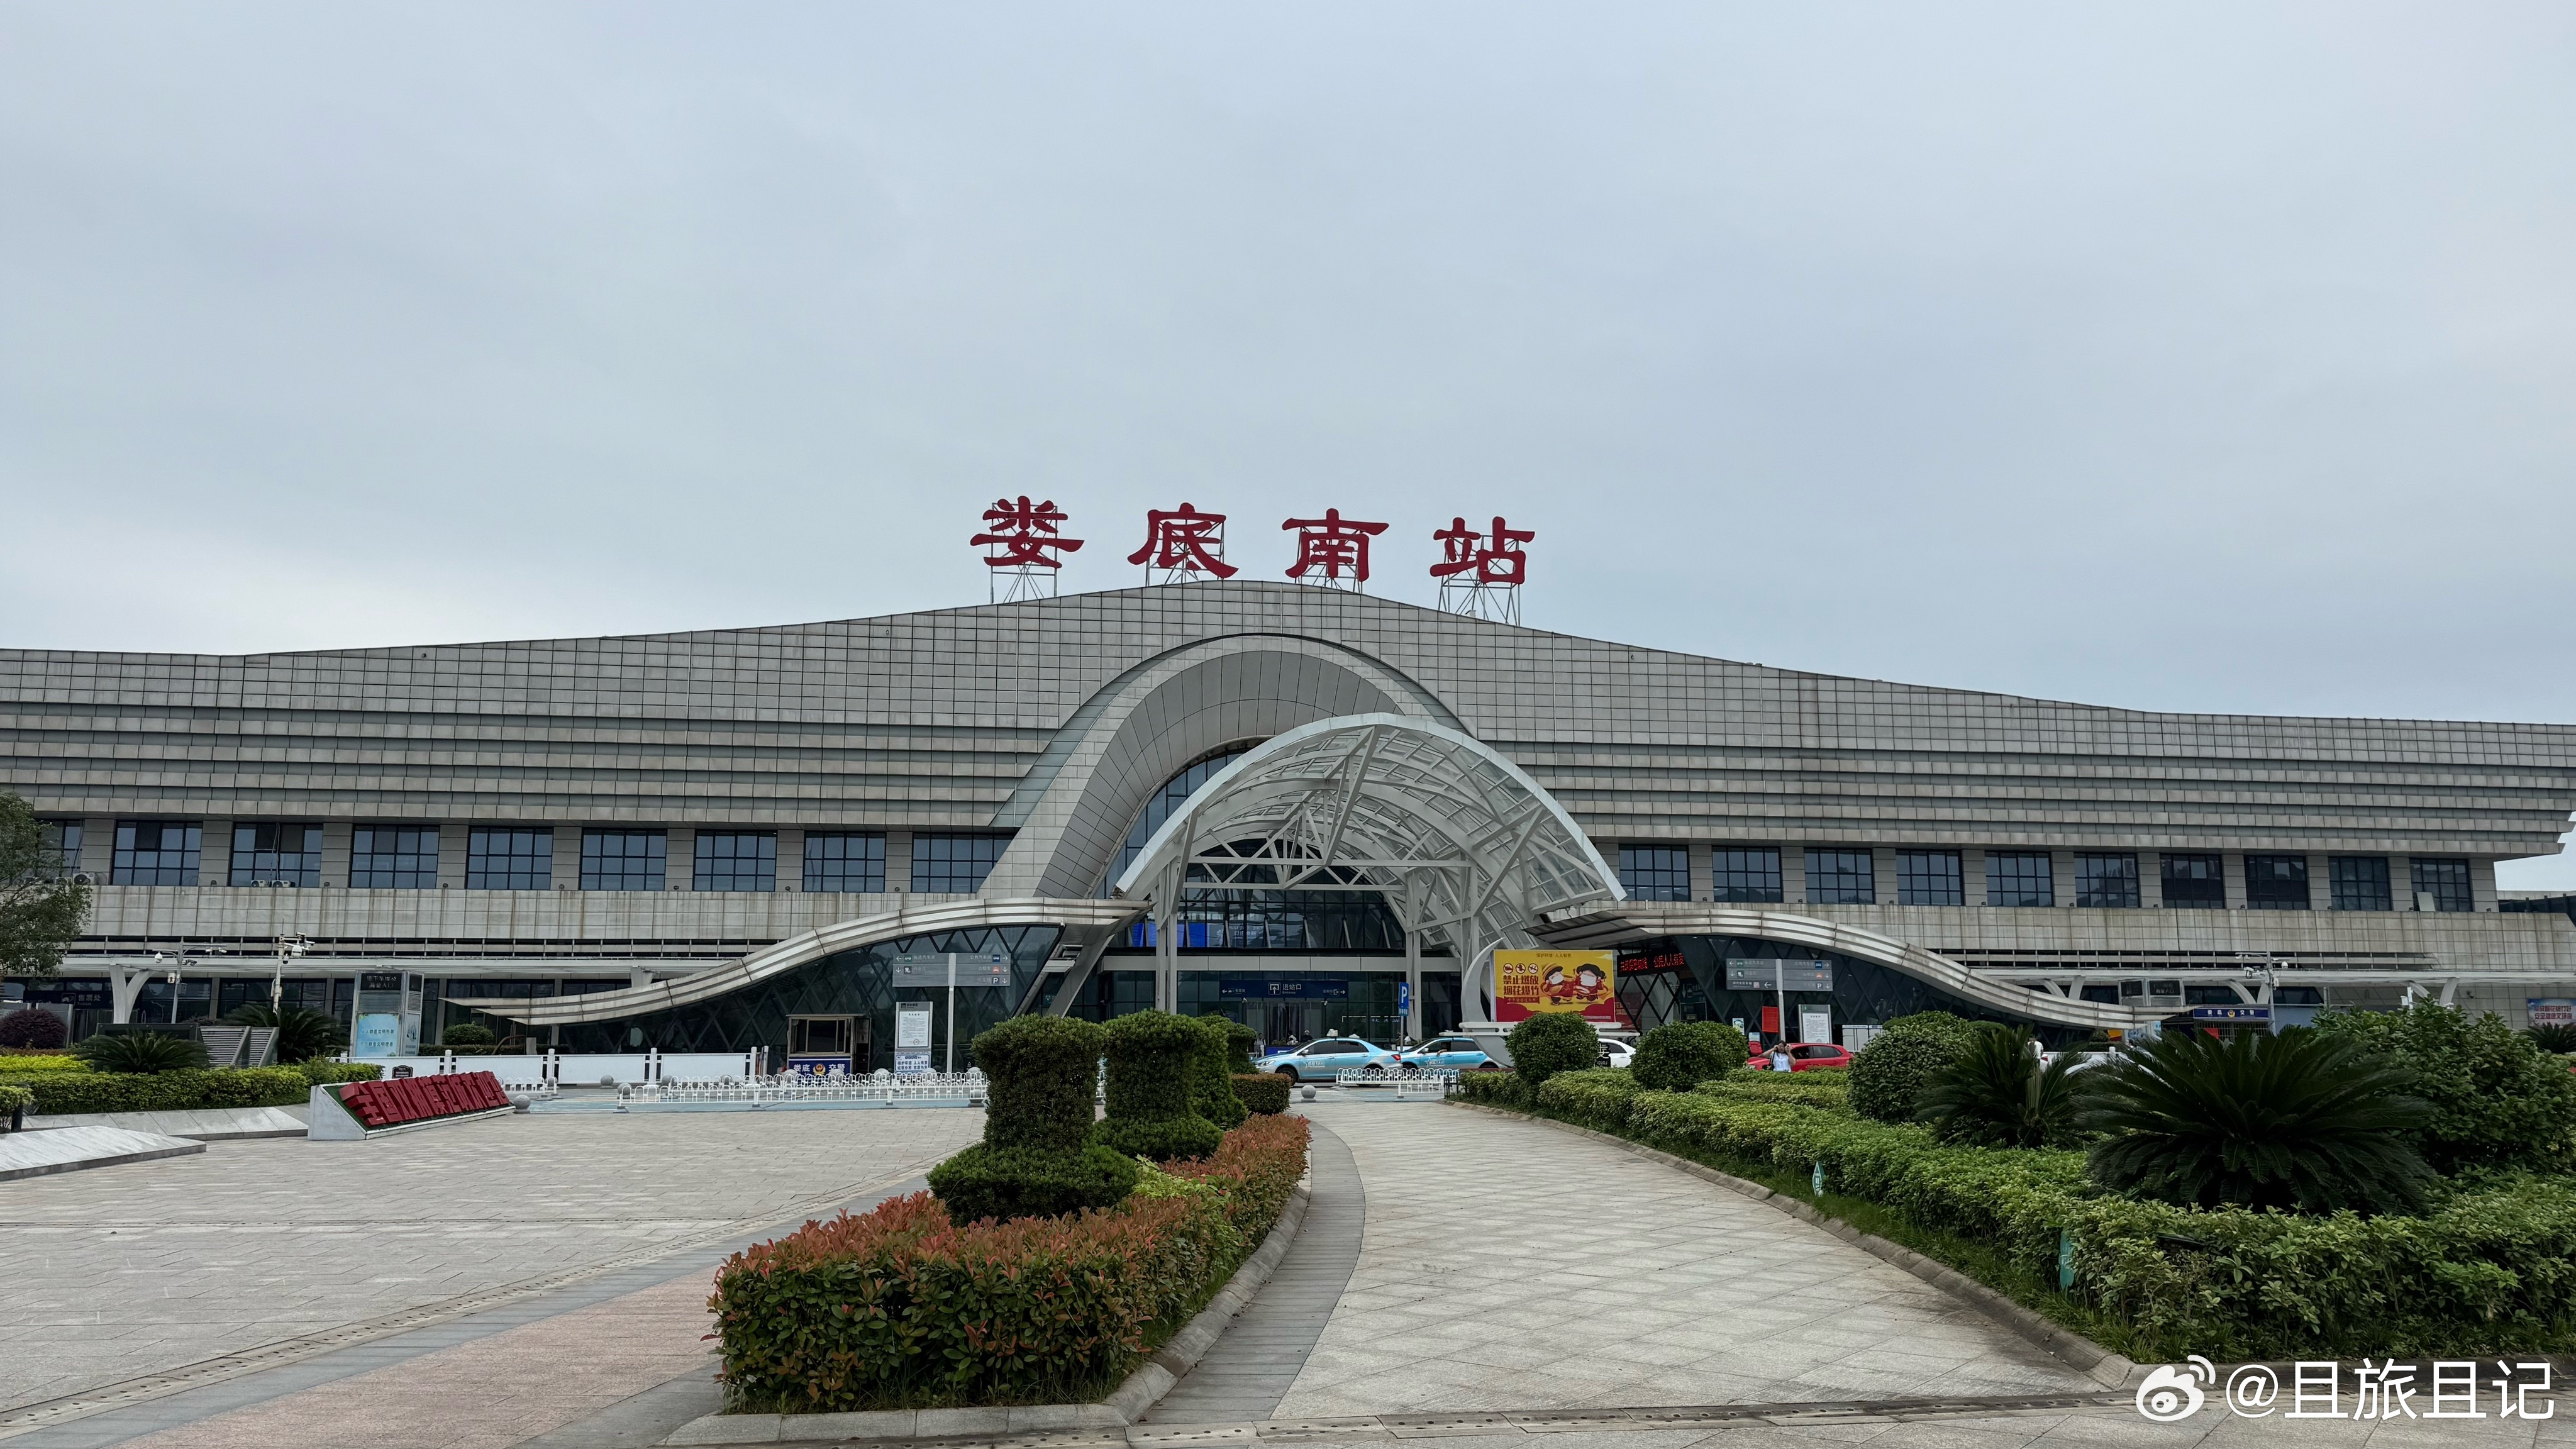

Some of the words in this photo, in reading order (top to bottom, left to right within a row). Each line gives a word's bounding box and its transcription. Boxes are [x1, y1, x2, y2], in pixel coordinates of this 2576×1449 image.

[969, 495, 1535, 585] 娄底南站
[1503, 975, 1539, 985] 禁止燃放
[1401, 985, 1407, 1003] P
[1503, 985, 1539, 996] 烟花爆竹
[793, 1063, 810, 1072] 娄底
